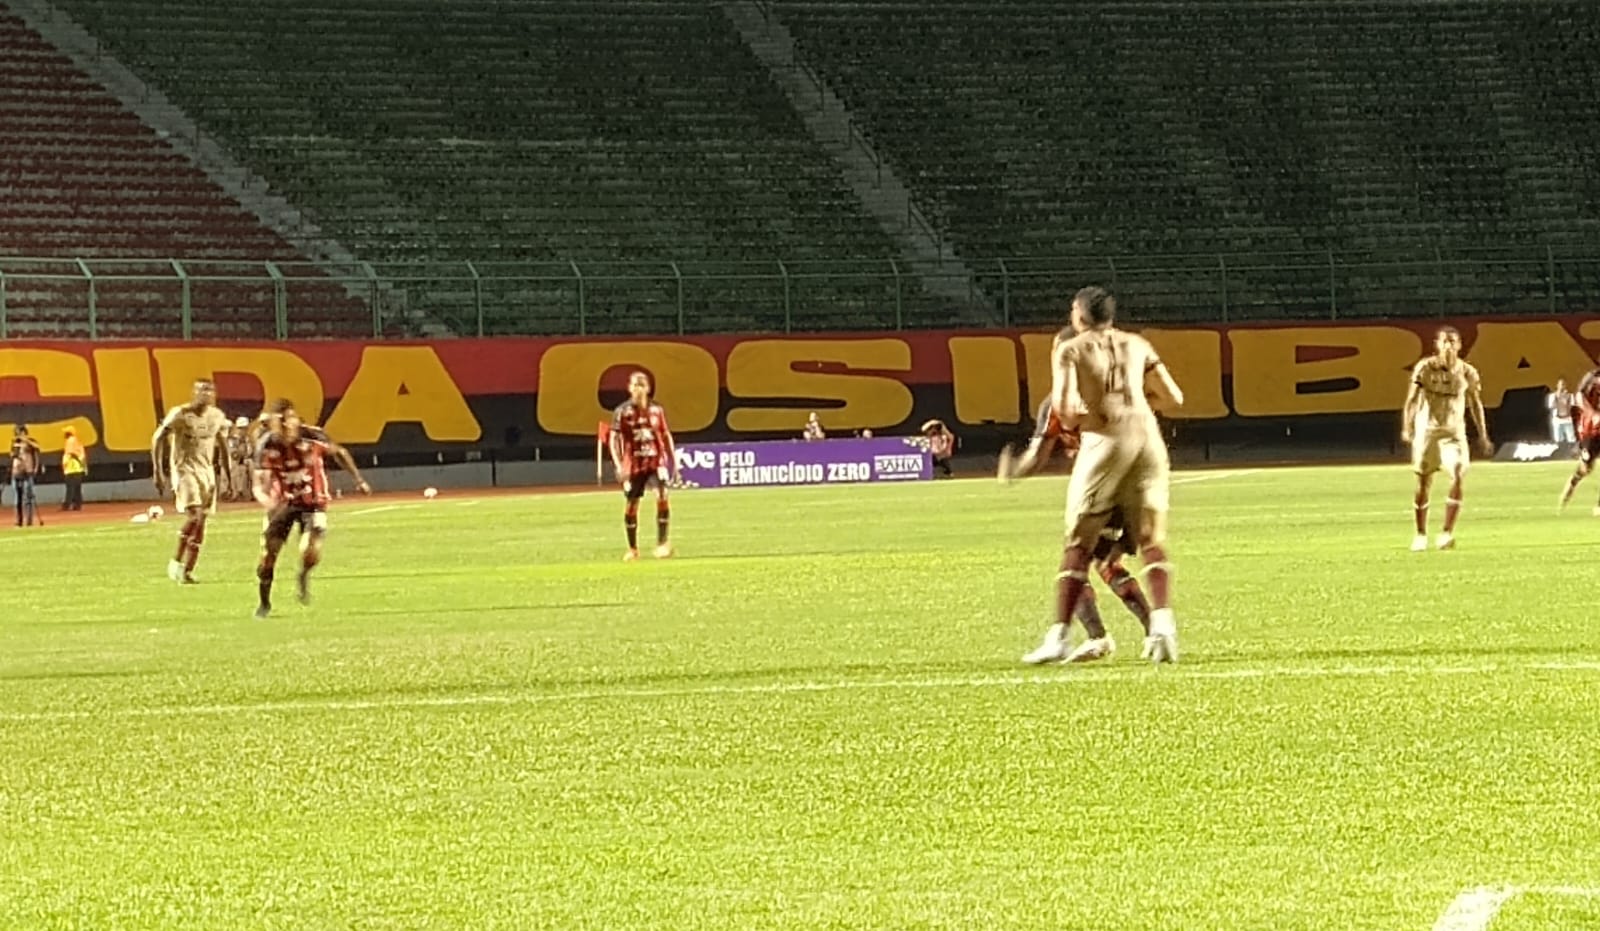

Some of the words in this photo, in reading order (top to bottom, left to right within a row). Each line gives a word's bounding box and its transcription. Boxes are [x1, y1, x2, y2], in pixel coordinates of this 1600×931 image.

[538, 338, 914, 436] OS
[719, 451, 755, 467] PELO
[720, 461, 823, 485] FEMINICÍDIO
[827, 462, 870, 482] ZERO
